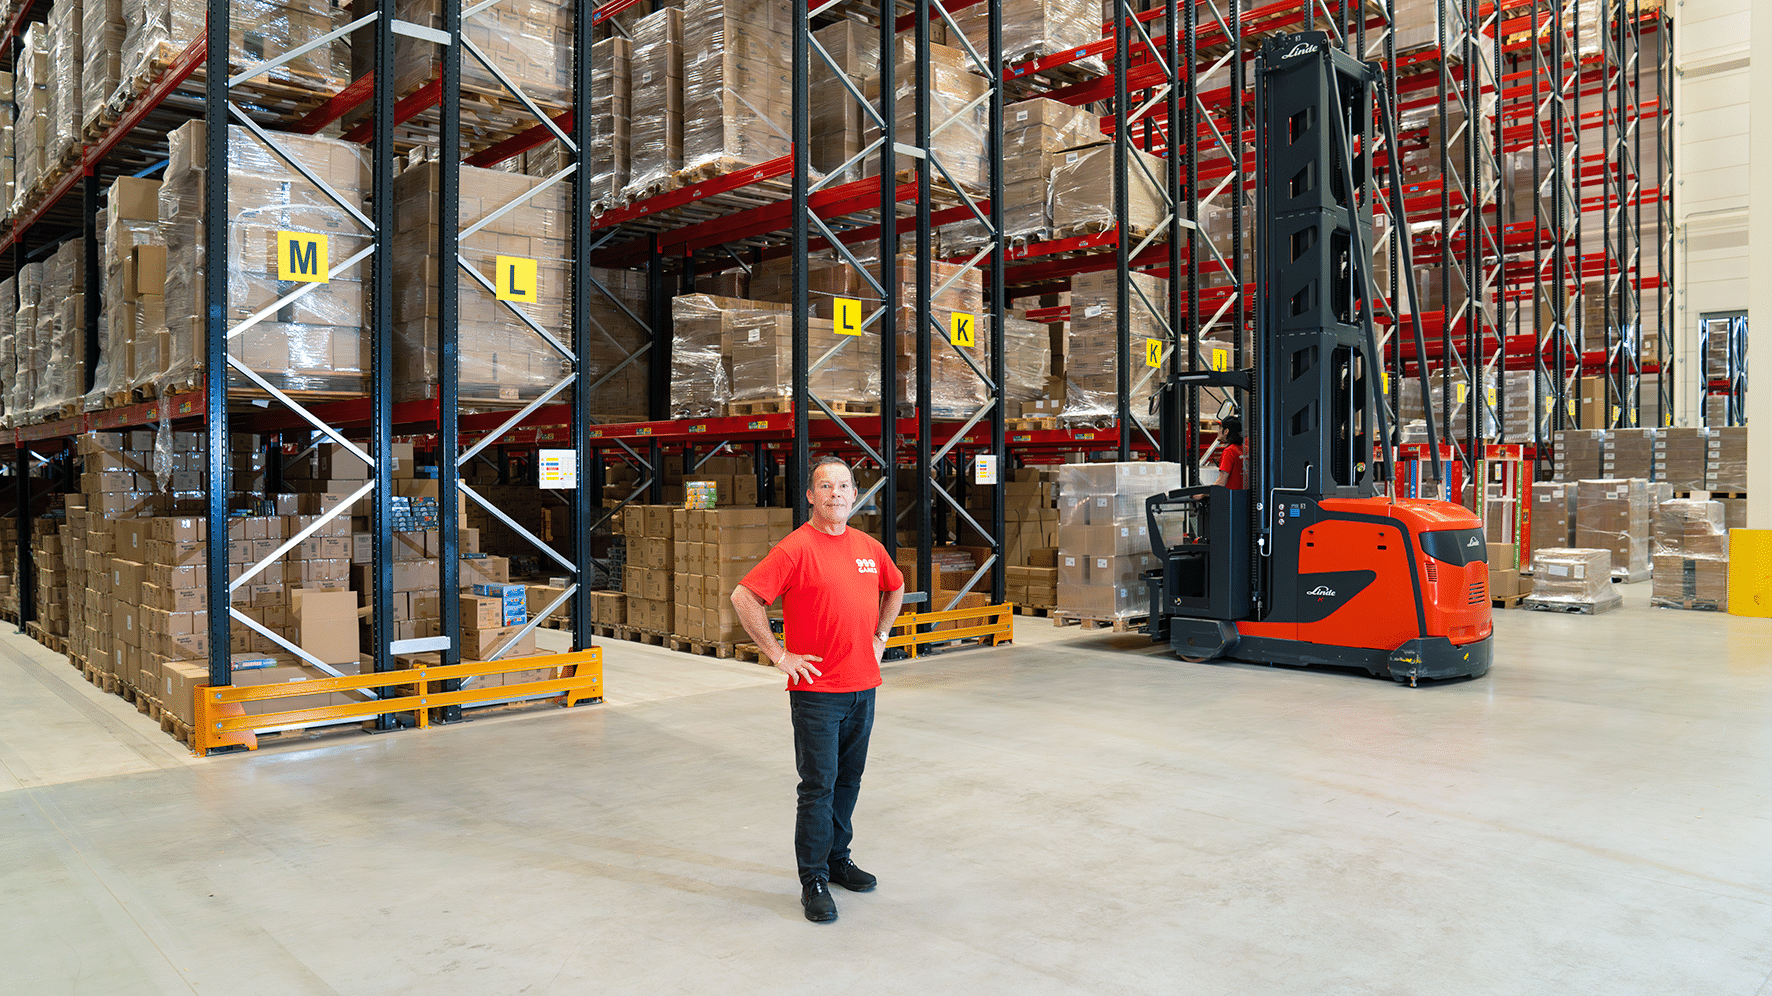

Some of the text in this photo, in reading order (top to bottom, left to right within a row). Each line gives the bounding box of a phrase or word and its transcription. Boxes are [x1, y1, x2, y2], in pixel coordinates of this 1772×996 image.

[1281, 42, 1318, 59] Linde
[289, 239, 317, 275] M
[509, 264, 526, 296] L
[842, 304, 855, 330] L
[957, 318, 969, 342] K
[1149, 343, 1159, 364] K
[855, 558, 876, 568] 999
[858, 566, 878, 574] GAMES
[1306, 585, 1336, 597] Linde
